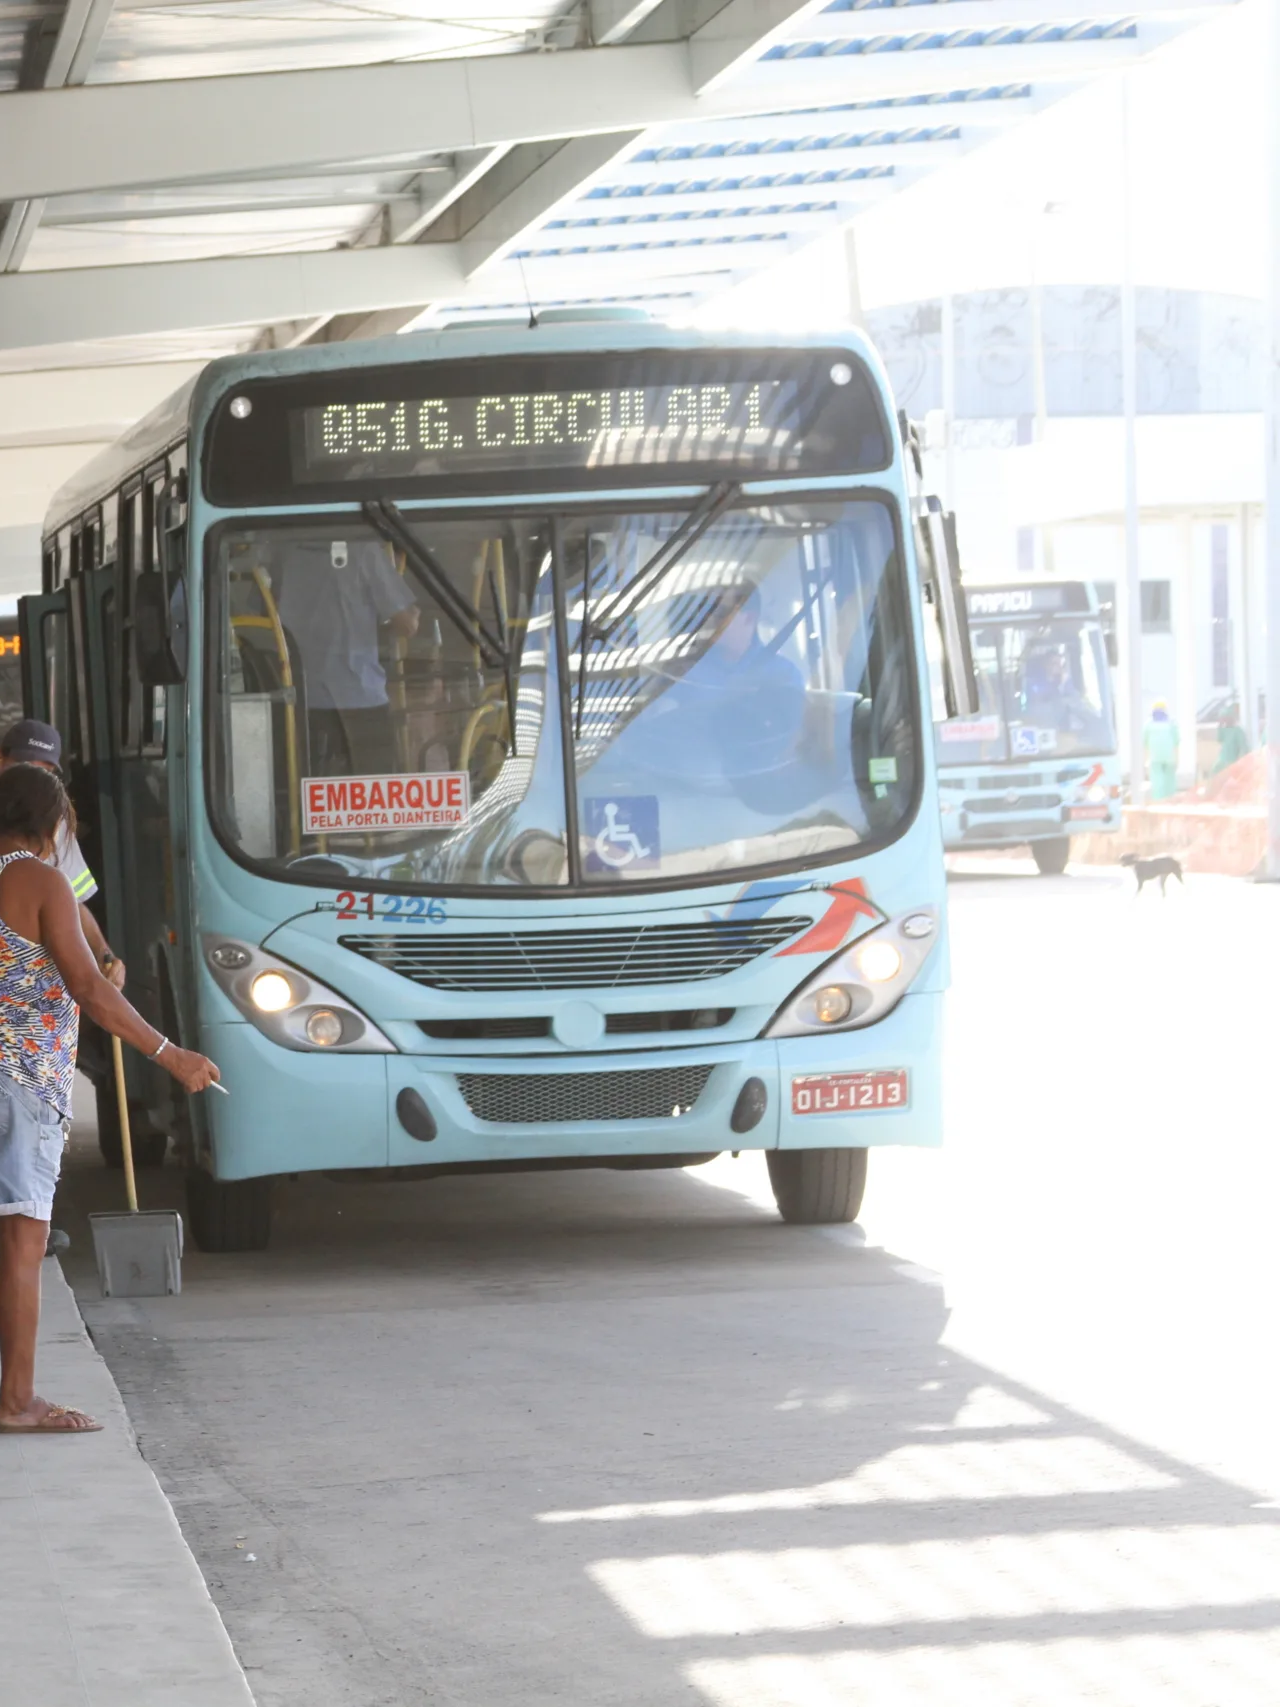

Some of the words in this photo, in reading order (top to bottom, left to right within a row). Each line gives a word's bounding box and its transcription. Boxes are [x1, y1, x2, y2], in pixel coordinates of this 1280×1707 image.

[970, 590, 1033, 614] PAPICU
[309, 778, 462, 813] EMBARQUE
[311, 815, 342, 828] PELA
[347, 813, 388, 826] PORTA
[393, 810, 462, 825] DIANTEIRA
